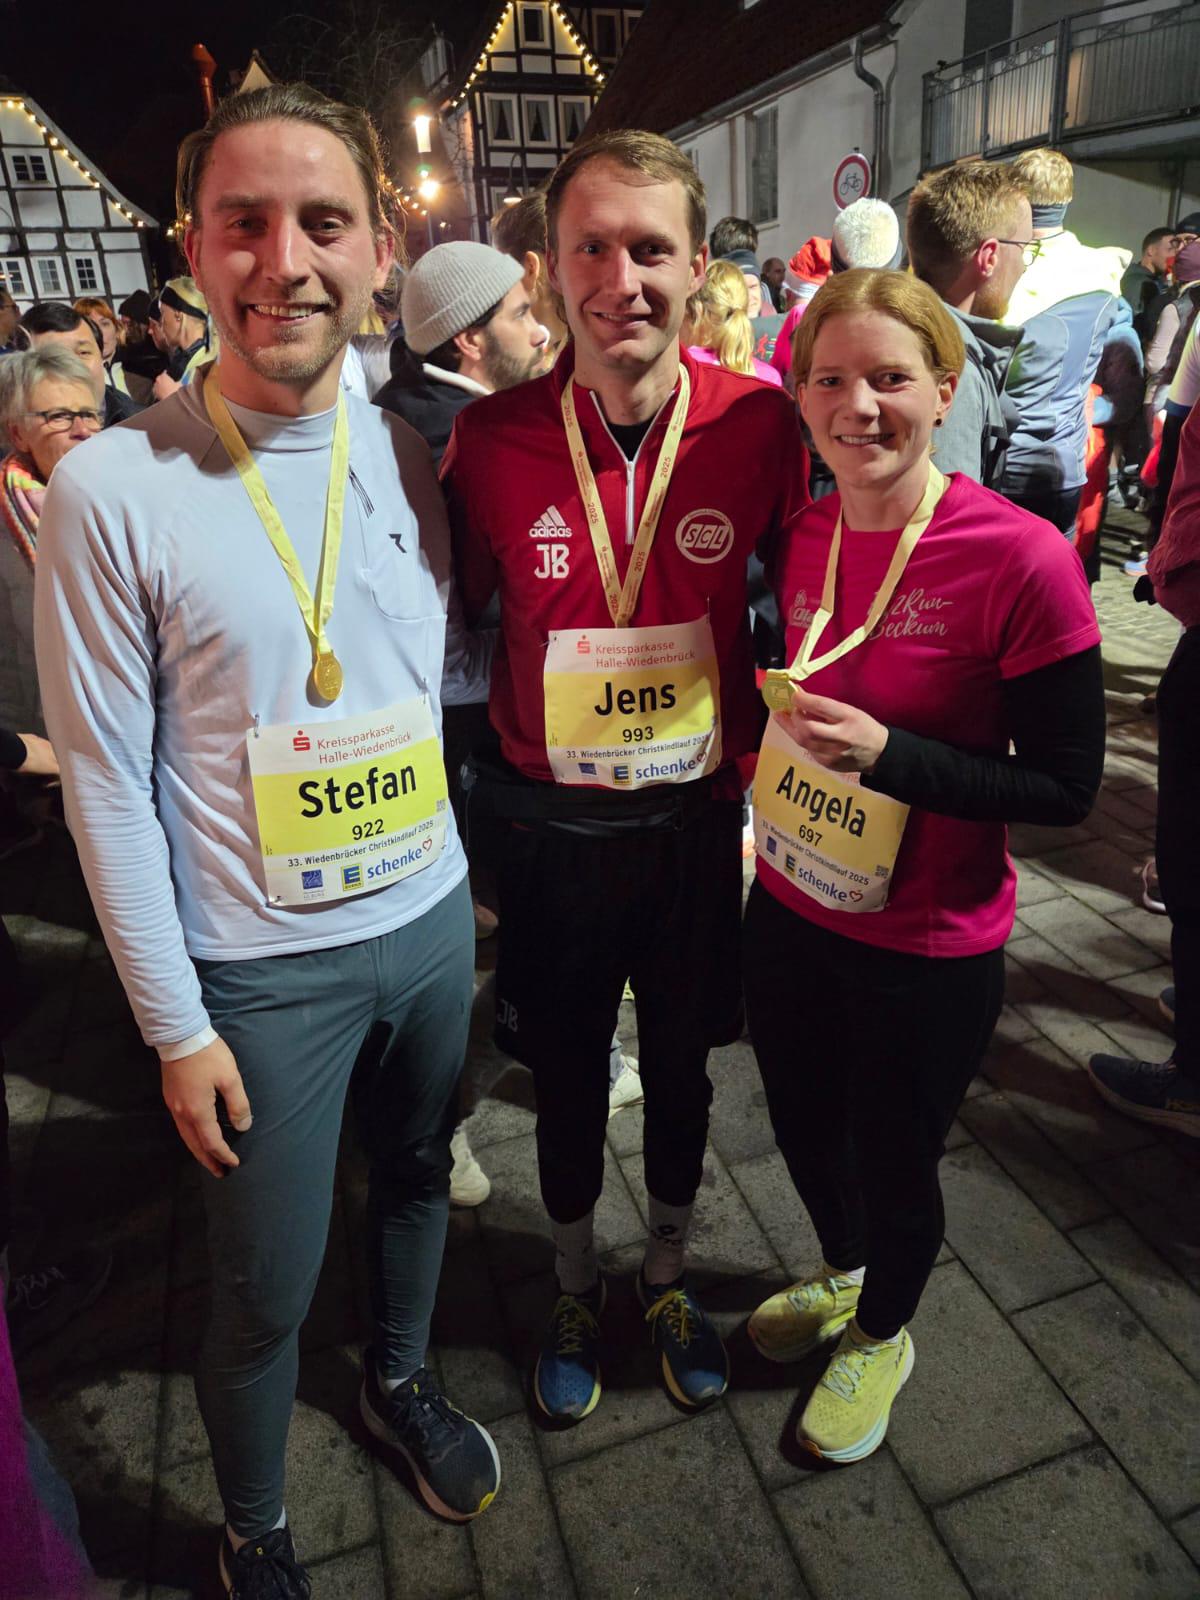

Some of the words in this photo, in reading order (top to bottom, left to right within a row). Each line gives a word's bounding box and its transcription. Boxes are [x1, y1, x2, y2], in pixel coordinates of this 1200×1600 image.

[660, 456, 671, 479] 2025
[587, 502, 599, 525] 2025
[529, 526, 573, 539] adidas
[684, 526, 726, 547] SCL
[534, 544, 570, 579] JB
[634, 551, 646, 572] 2025
[595, 641, 675, 655] Kreissparkasse
[596, 650, 696, 668] Halle-Wiedenbrück
[594, 682, 676, 716] Jens
[317, 723, 395, 750] Kreissparkasse
[622, 726, 654, 743] 993
[319, 732, 412, 764] Halle-Wiedenbrück
[566, 750, 579, 759] 33.
[580, 748, 635, 759] Wiedenbrücker
[635, 758, 696, 779] schenke
[299, 765, 416, 818] Stefan
[776, 766, 866, 838] Angela
[352, 818, 385, 841] 922
[799, 825, 822, 846] 697
[287, 859, 303, 868] 33.
[304, 845, 367, 865] Wiedenbrücker
[368, 829, 417, 852] Christkindllauf
[418, 819, 434, 834] 2025
[367, 848, 423, 879] schenke
[798, 867, 848, 903] schenke
[849, 871, 870, 886] 2025
[497, 998, 519, 1033] JB
